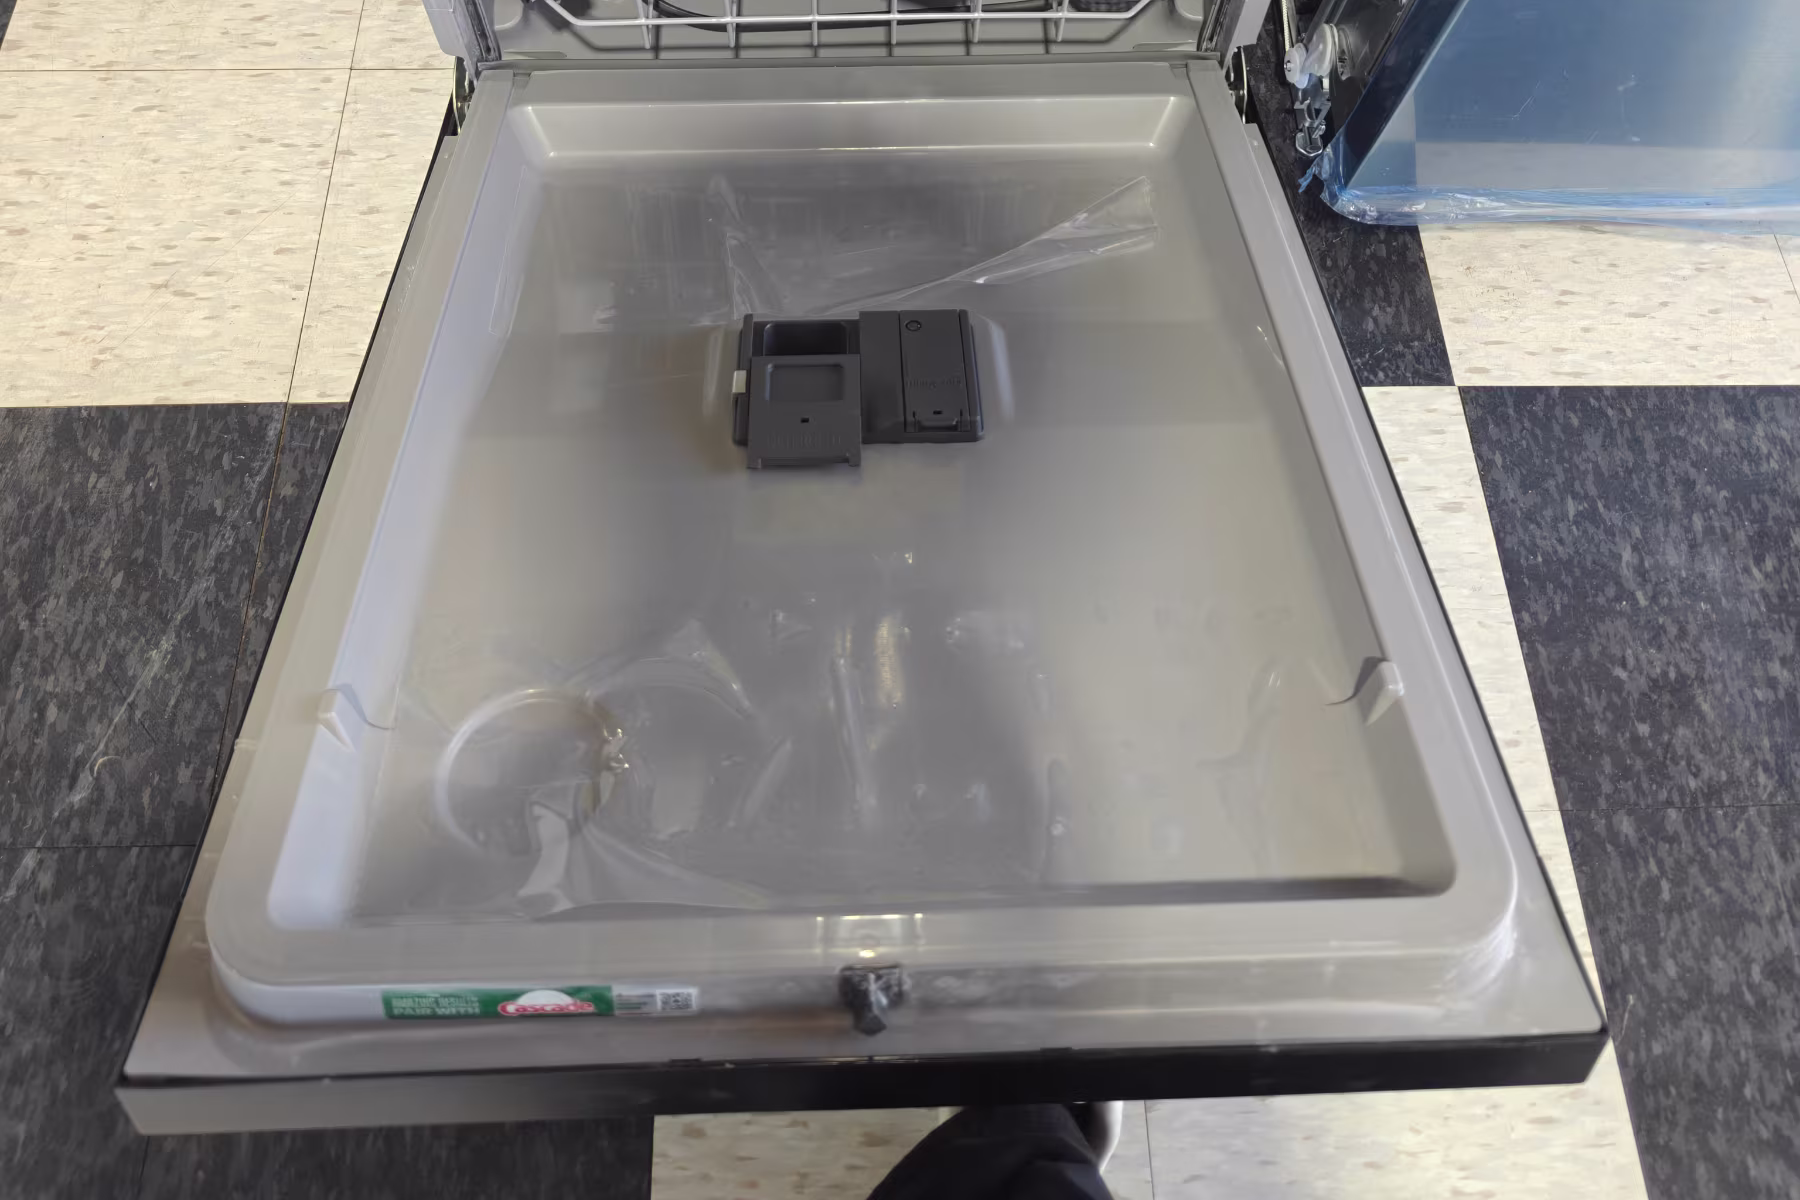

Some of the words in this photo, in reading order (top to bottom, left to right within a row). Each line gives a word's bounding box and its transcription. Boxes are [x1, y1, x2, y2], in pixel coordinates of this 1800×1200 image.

[392, 1006, 433, 1016] PAIR
[435, 1006, 480, 1015] WITH
[498, 1002, 595, 1016] Cascade
